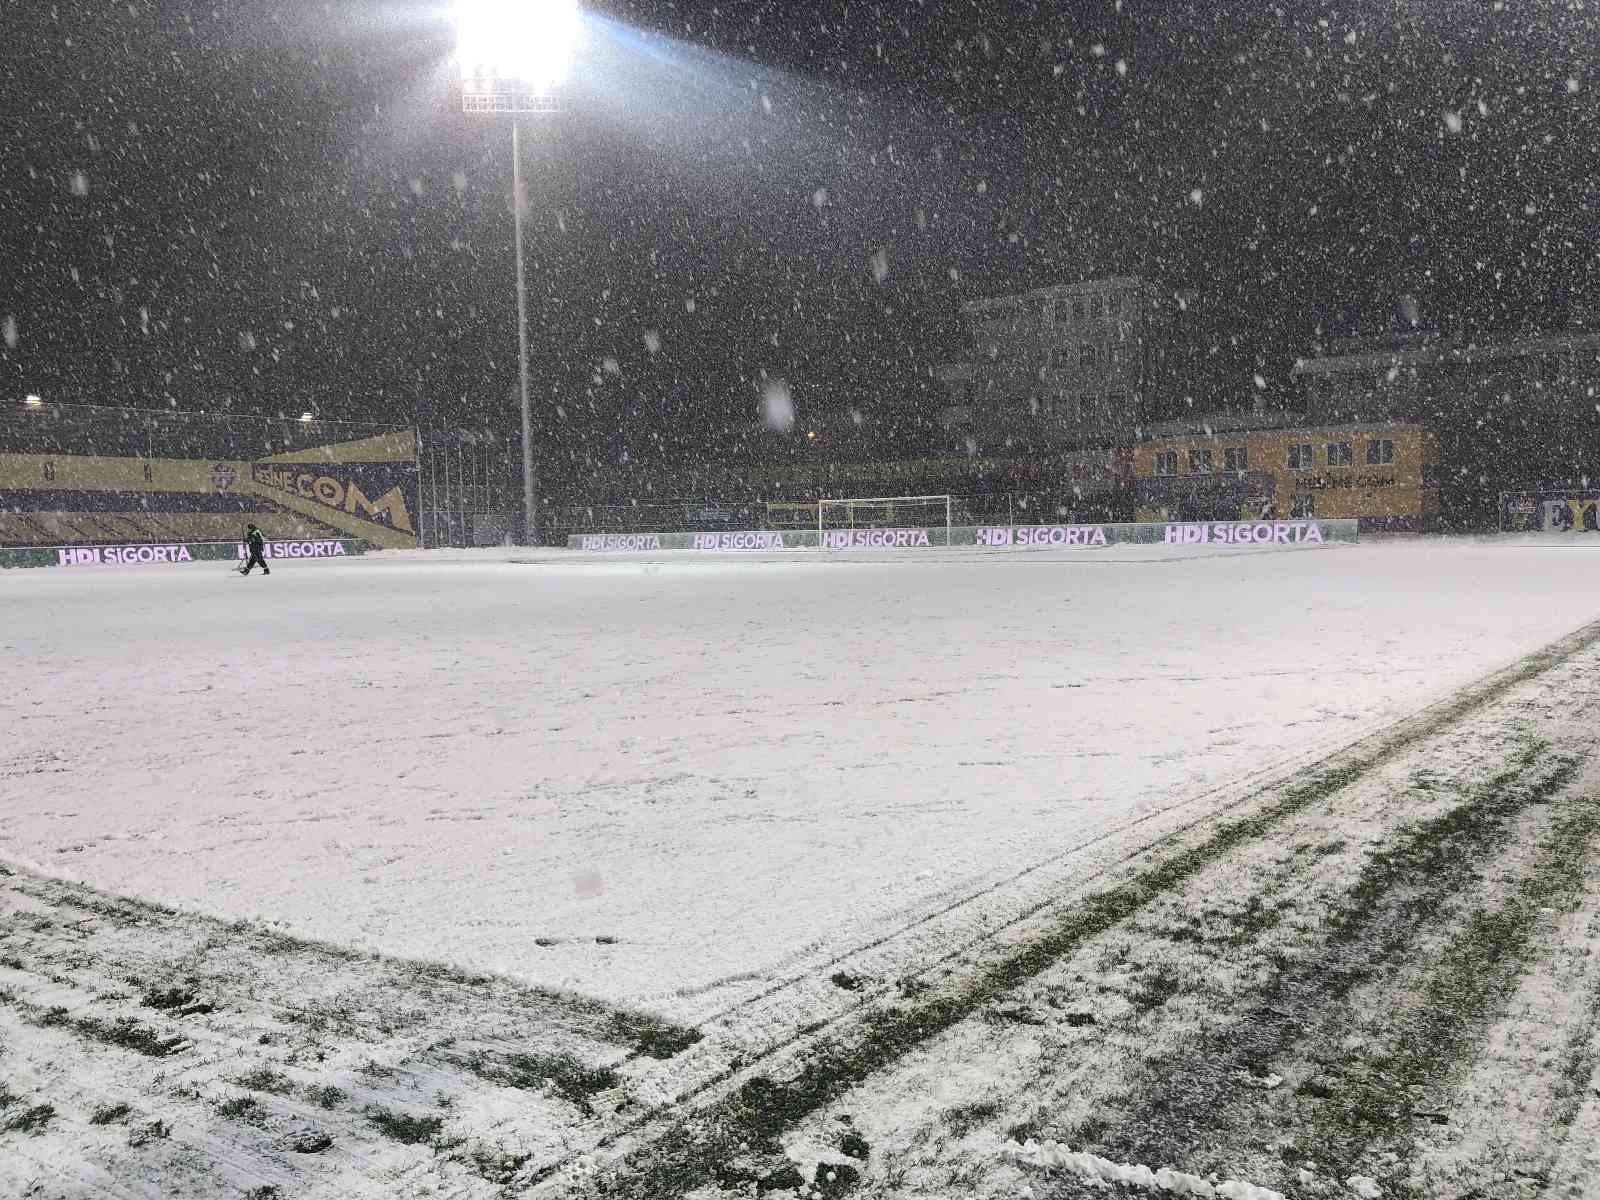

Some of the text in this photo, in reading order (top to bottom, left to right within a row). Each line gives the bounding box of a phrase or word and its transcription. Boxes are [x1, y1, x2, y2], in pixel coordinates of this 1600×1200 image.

[1542, 499, 1600, 532] EY
[694, 533, 720, 550] HDI
[823, 530, 853, 548] HDI
[976, 528, 1013, 545] HDI
[1164, 525, 1208, 544] HDI
[58, 547, 100, 567] HDI
[237, 542, 272, 560] HI
